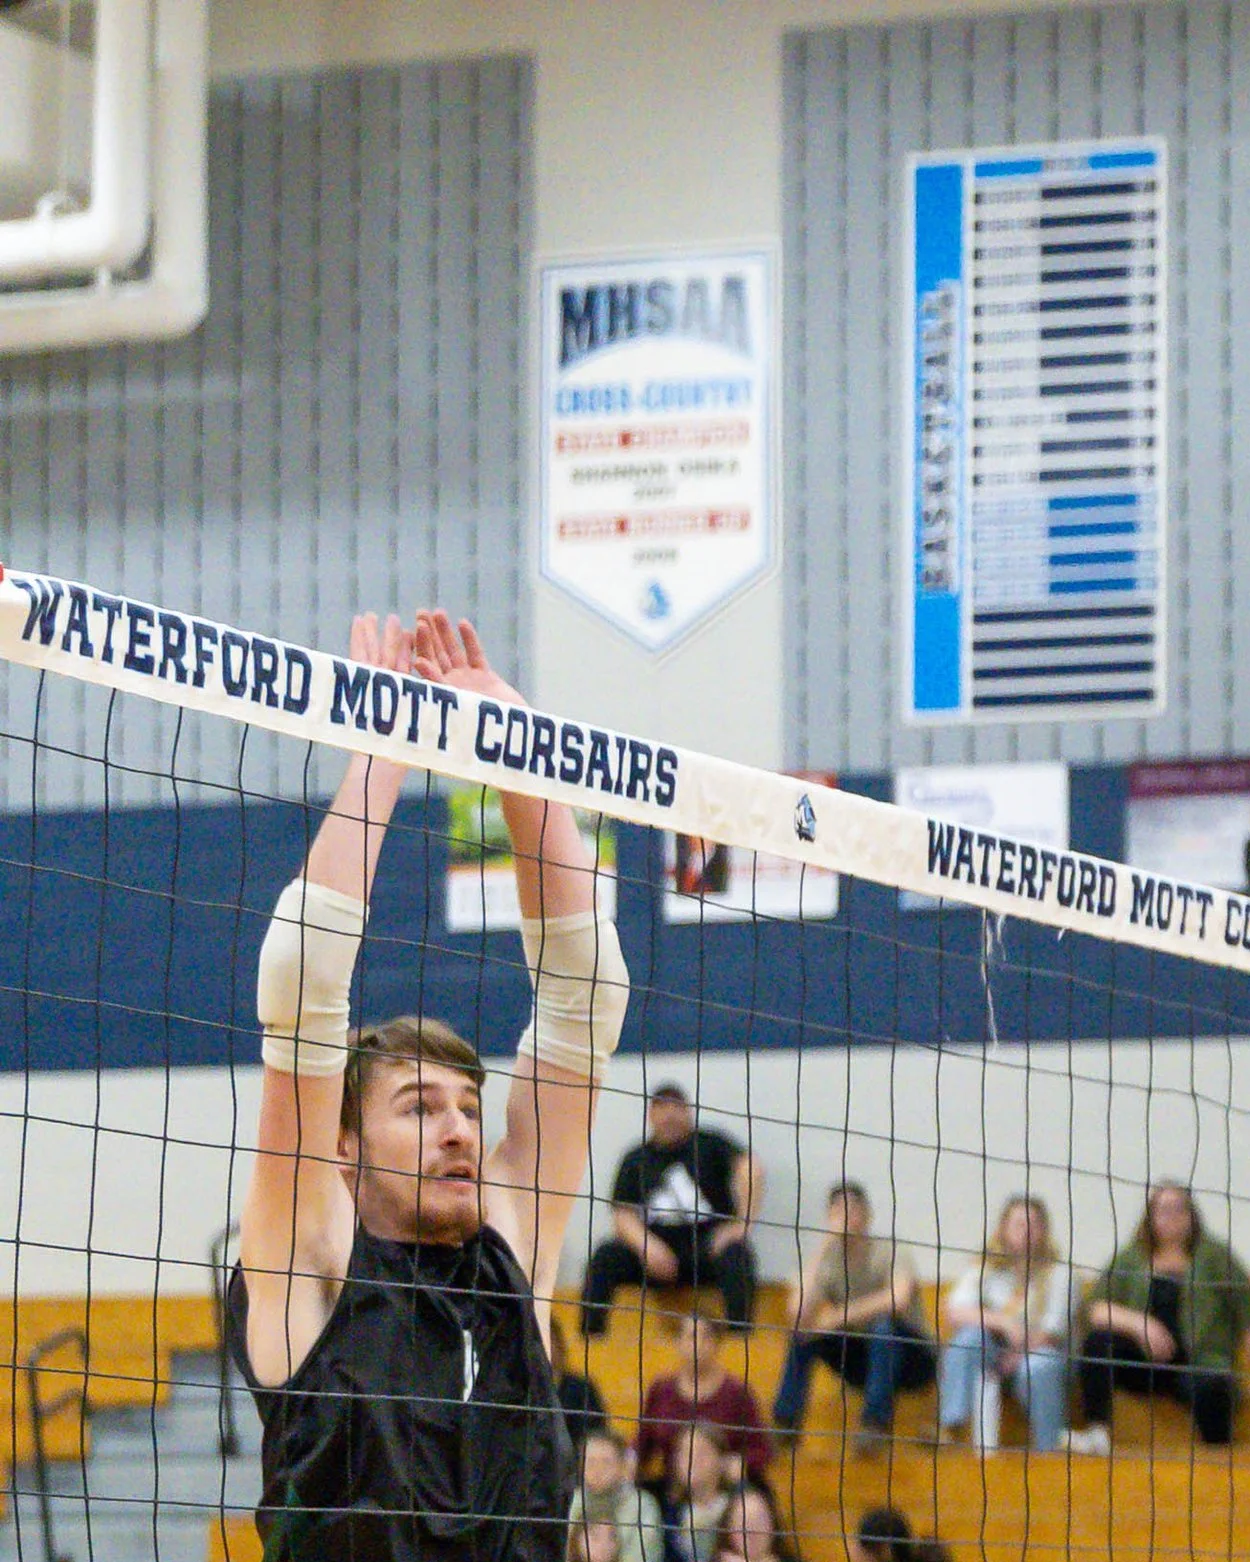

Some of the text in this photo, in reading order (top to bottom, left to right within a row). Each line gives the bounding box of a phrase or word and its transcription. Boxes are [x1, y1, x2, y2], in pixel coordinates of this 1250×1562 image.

[560, 275, 754, 371] MHSAA
[10, 577, 679, 807] WATERFORD MOTT CORSAIRS
[926, 820, 1117, 918] WATERFORD
[1131, 874, 1214, 942] MOTT
